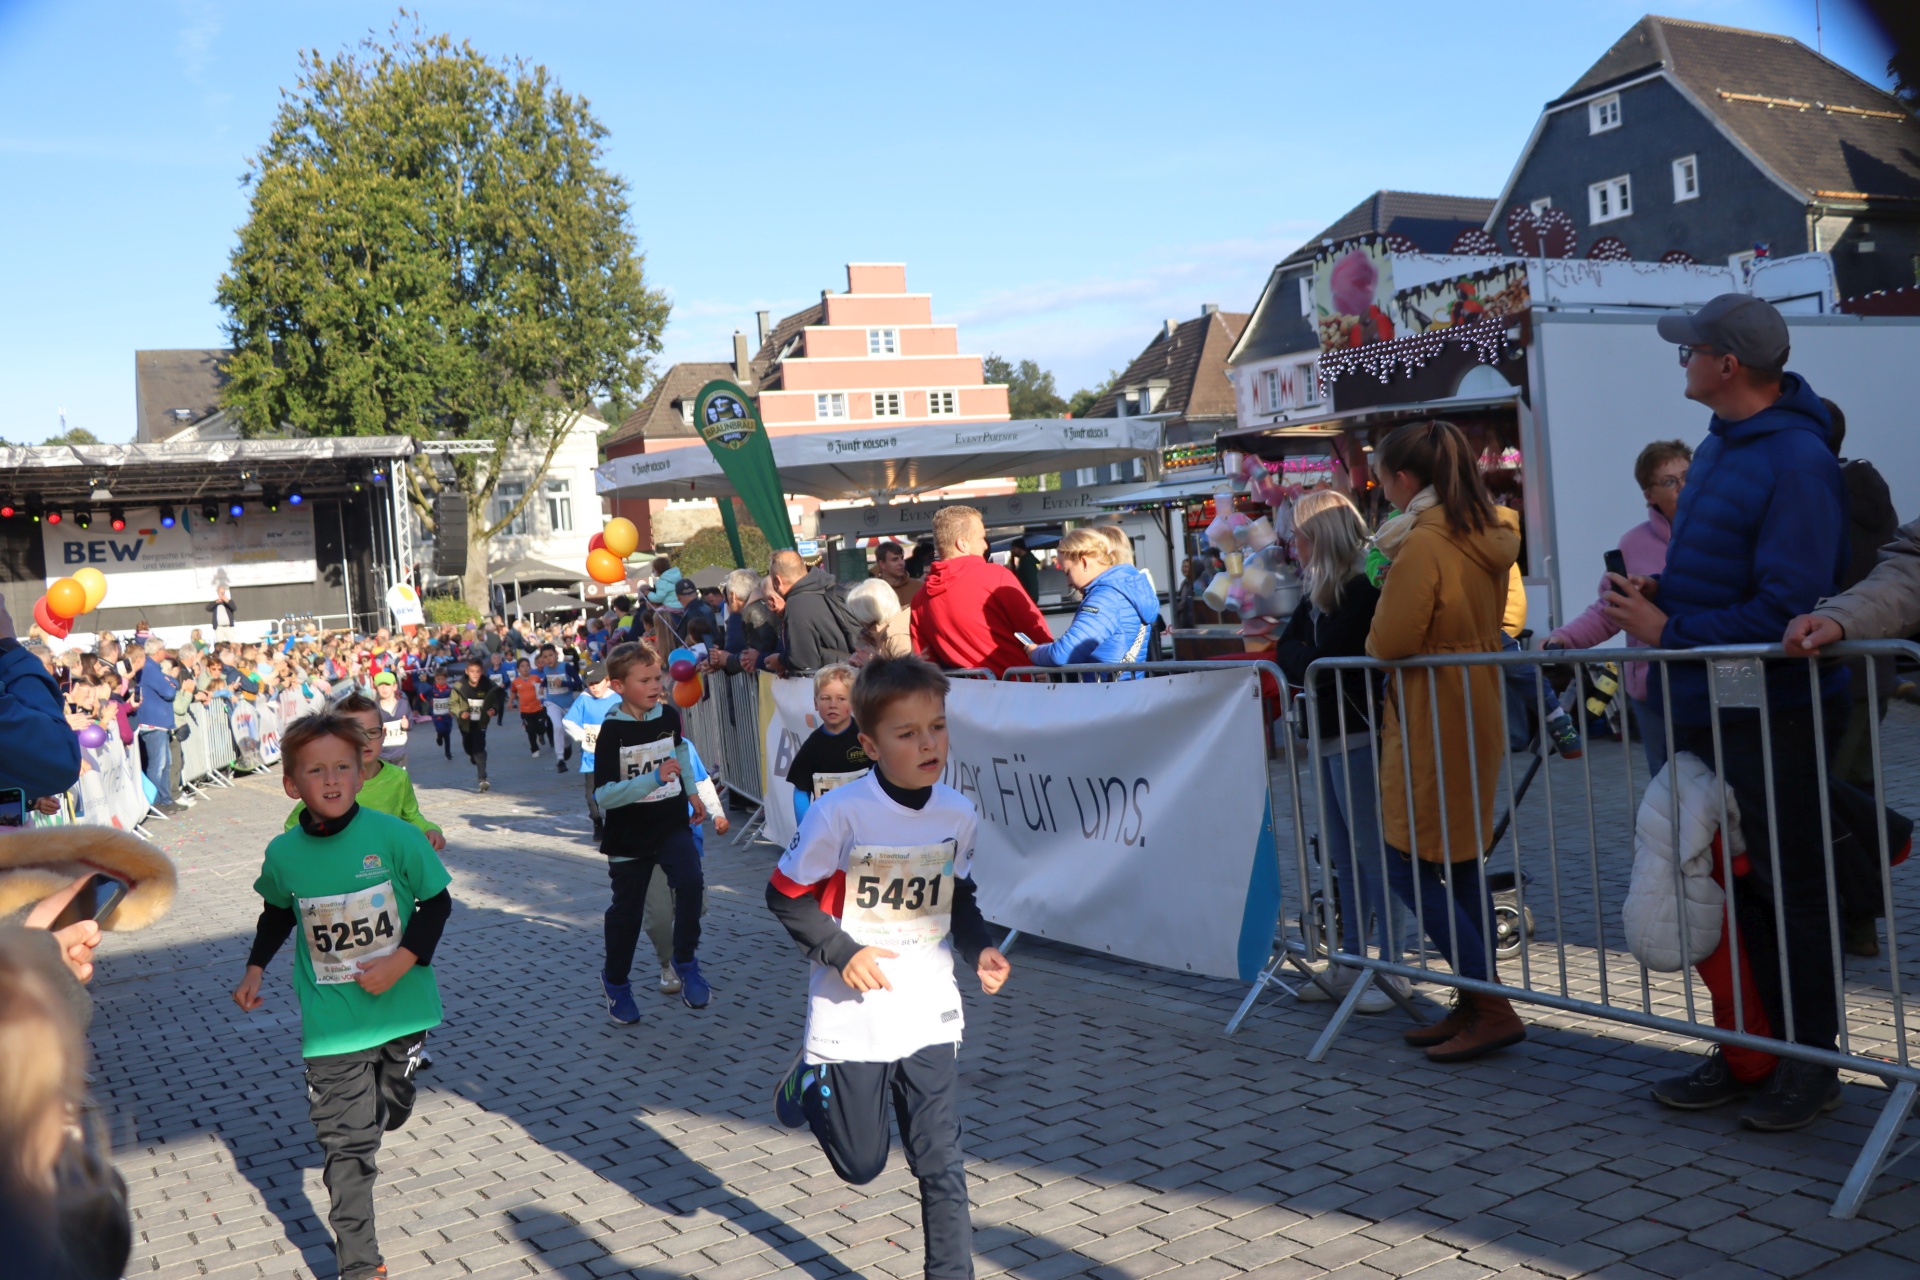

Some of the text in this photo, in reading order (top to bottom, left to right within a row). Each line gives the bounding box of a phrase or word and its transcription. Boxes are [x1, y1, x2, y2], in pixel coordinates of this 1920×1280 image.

[862, 438, 889, 449] KÖLSCH
[64, 538, 144, 564] BEW
[585, 732, 598, 743] 53
[992, 753, 1057, 833] Für
[1067, 776, 1150, 848] uns.
[856, 873, 942, 911] 5431
[312, 909, 394, 953] 5254
[901, 938, 919, 946] BEW
